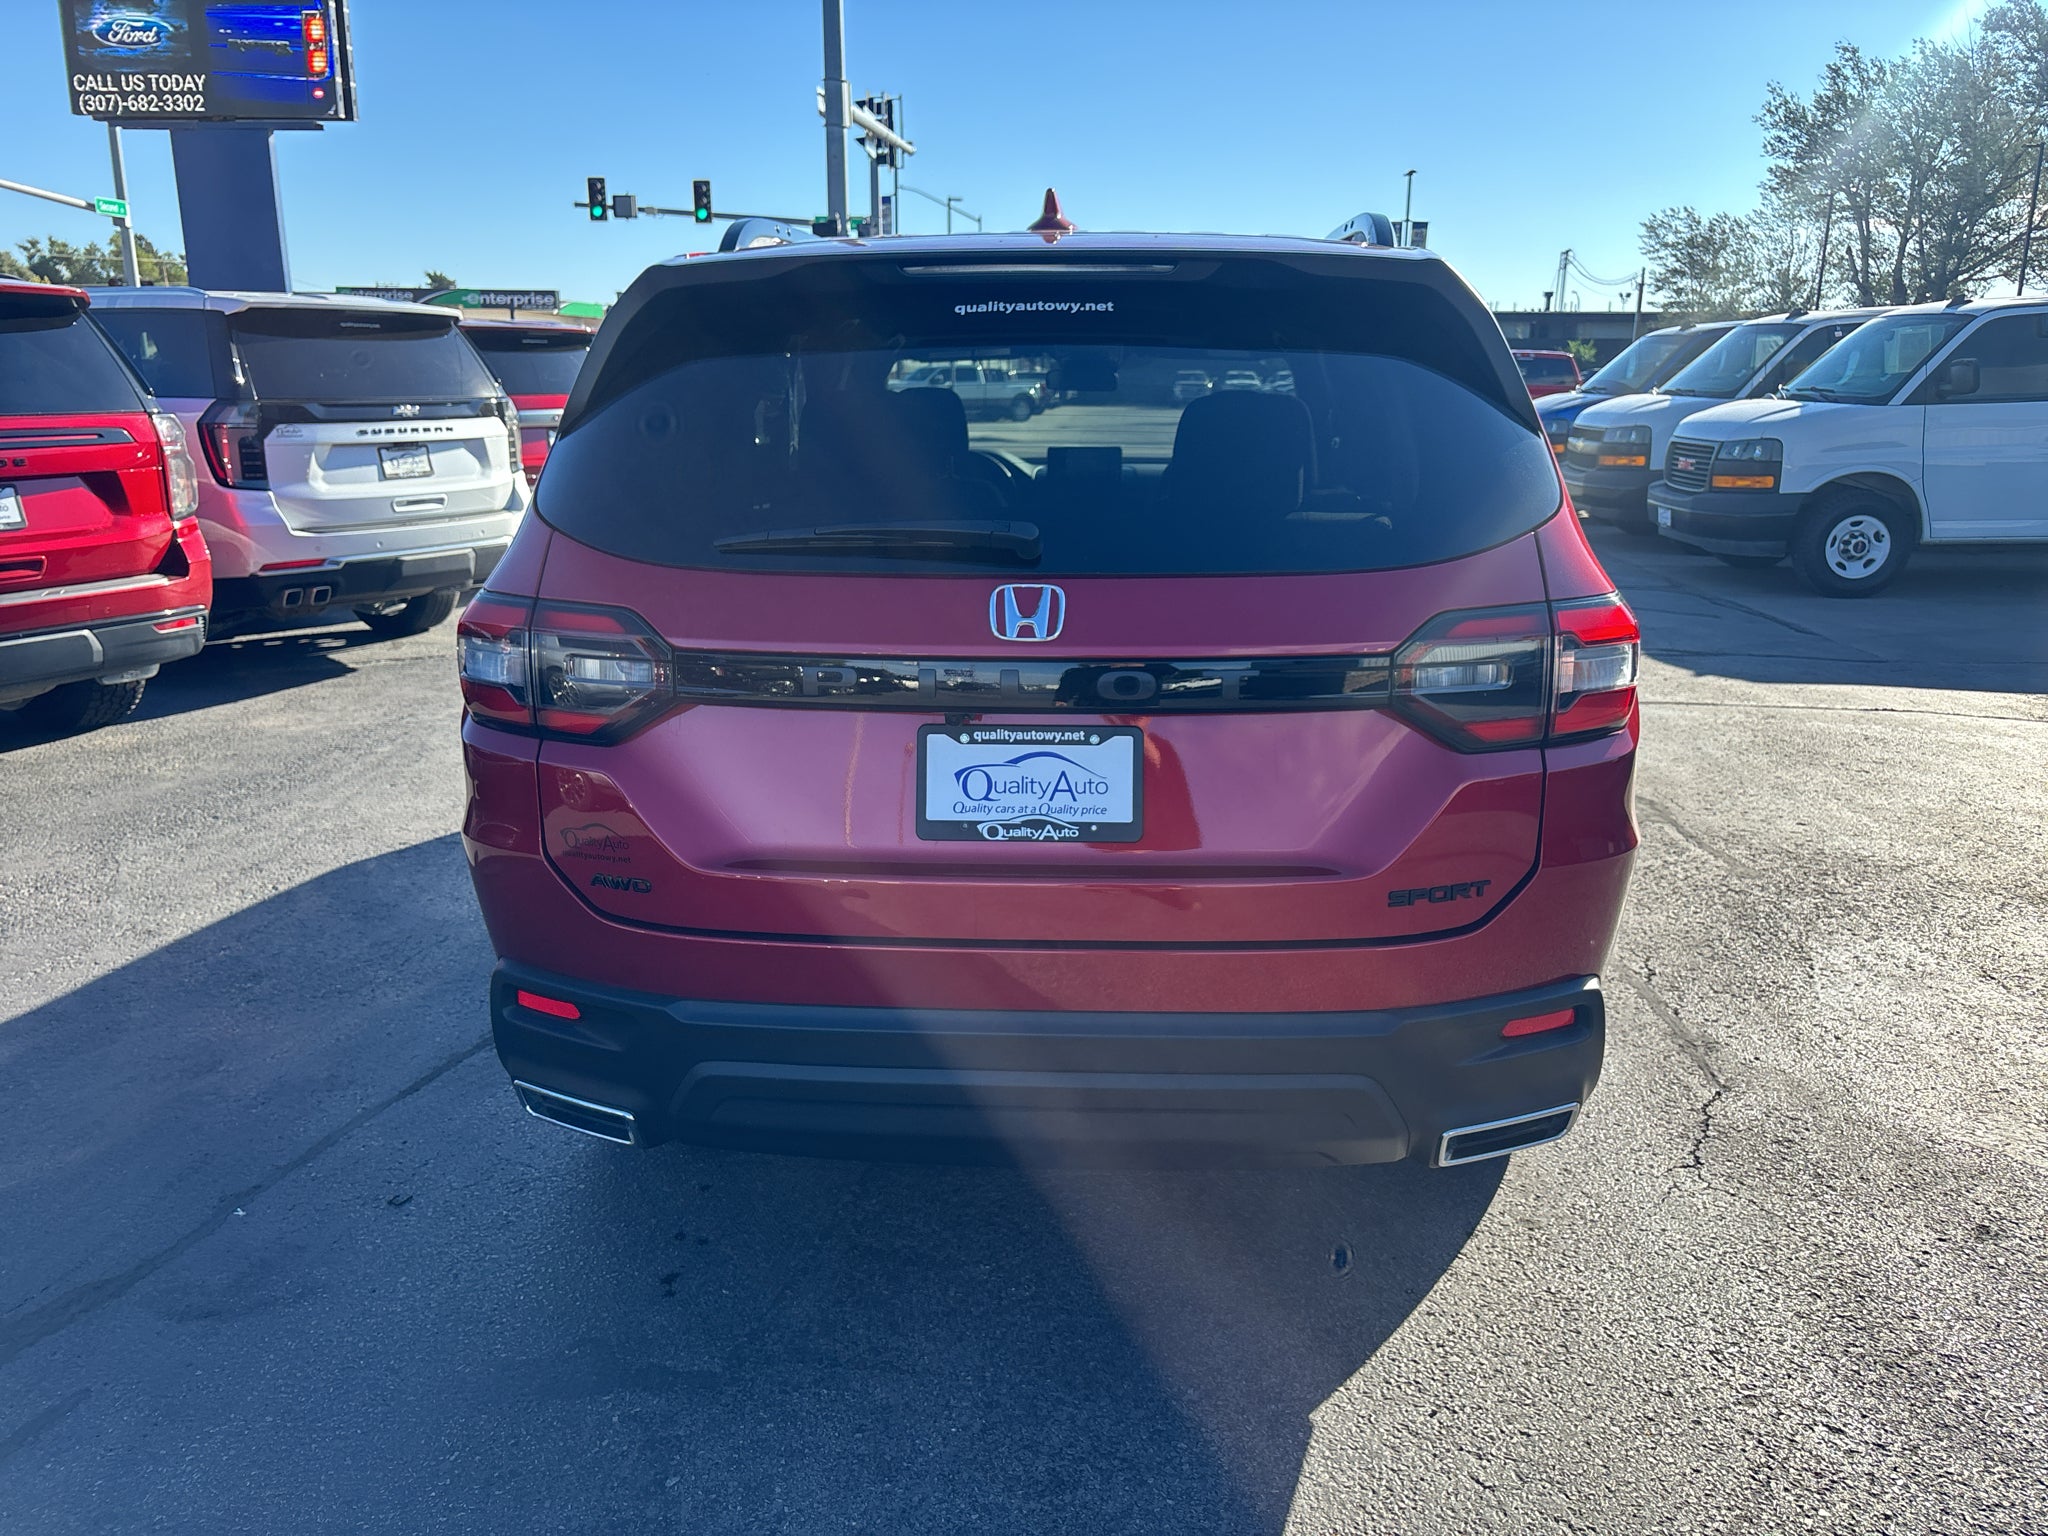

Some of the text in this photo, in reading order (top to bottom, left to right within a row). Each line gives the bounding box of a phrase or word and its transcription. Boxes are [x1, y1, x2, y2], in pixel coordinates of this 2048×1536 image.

[107, 20, 158, 43] Ford
[73, 74, 206, 92] CALL US TODAY
[79, 94, 206, 115] (307)-682-3302
[462, 292, 555, 307] enterprise
[954, 301, 1115, 315] qualityautowy.net
[800, 666, 1260, 699] PILOT
[973, 729, 1086, 743] qualityautowy.net
[952, 801, 1108, 817] Quality cars at a Quality price
[590, 872, 653, 894] AWD
[1387, 879, 1493, 908] SPORT
